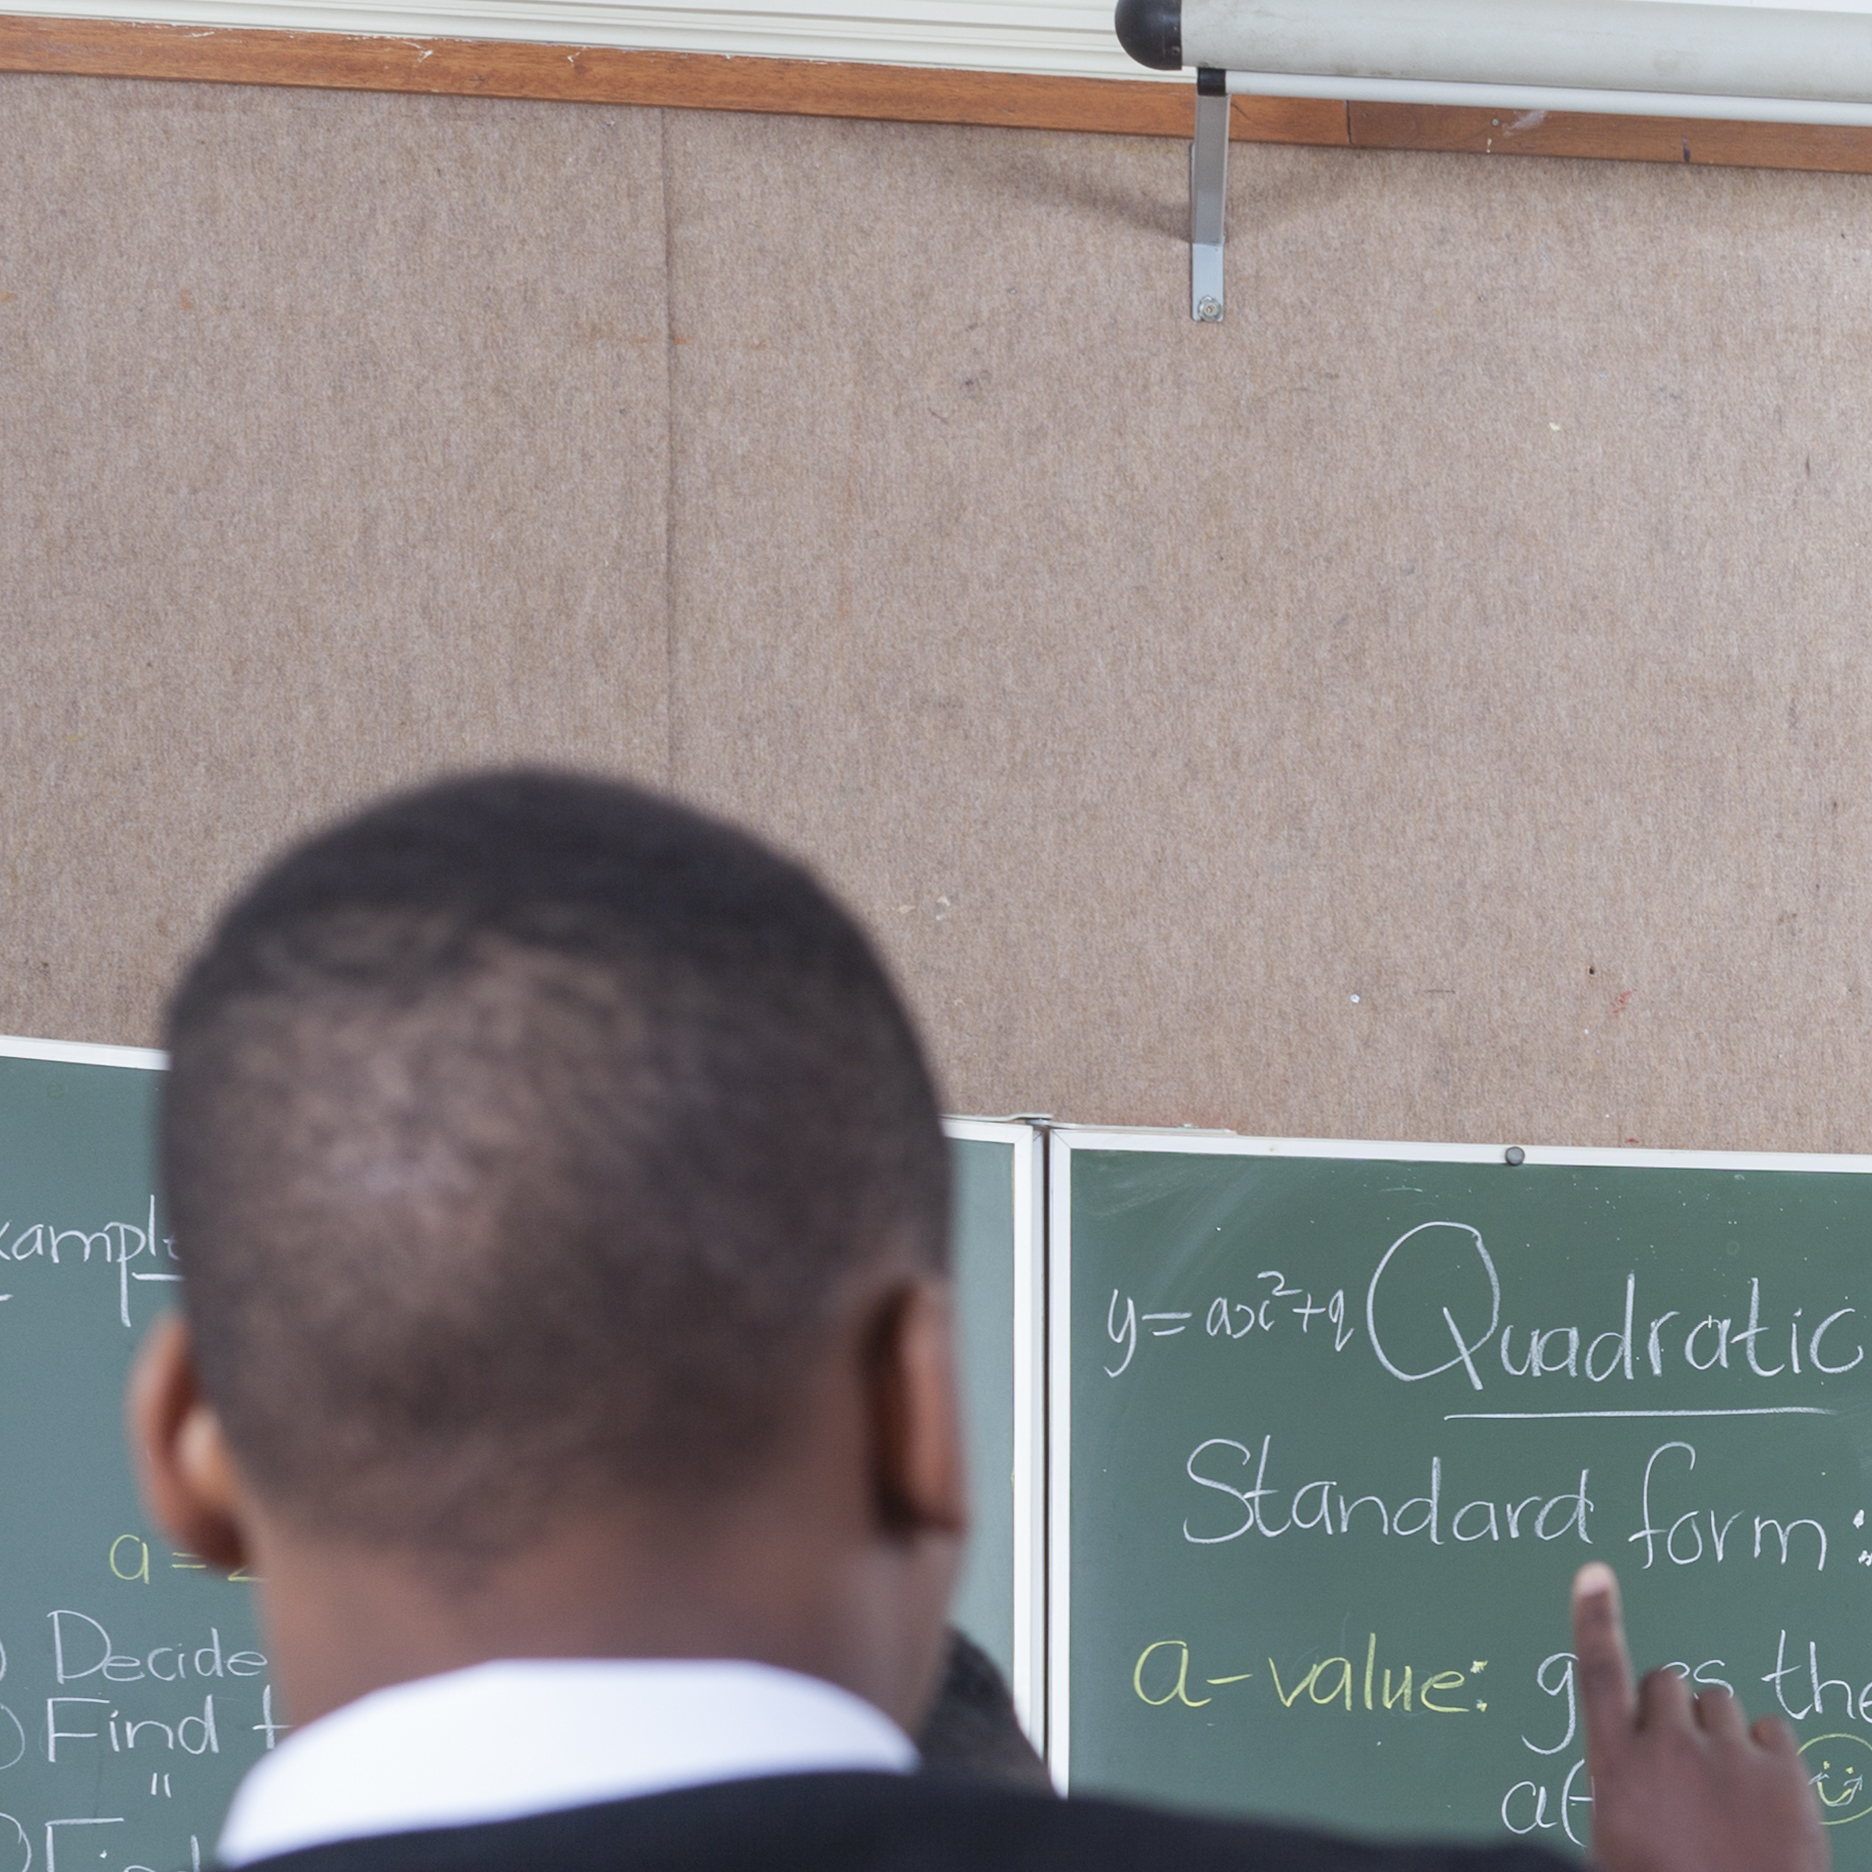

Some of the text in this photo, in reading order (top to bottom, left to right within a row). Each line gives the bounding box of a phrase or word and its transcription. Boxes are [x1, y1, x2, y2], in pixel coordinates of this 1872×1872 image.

[1366, 1221, 1864, 1391] Quadratic
[1183, 1433, 1595, 1546] Standard
[47, 1610, 269, 1685] Decide
[47, 1693, 220, 1764] Find
